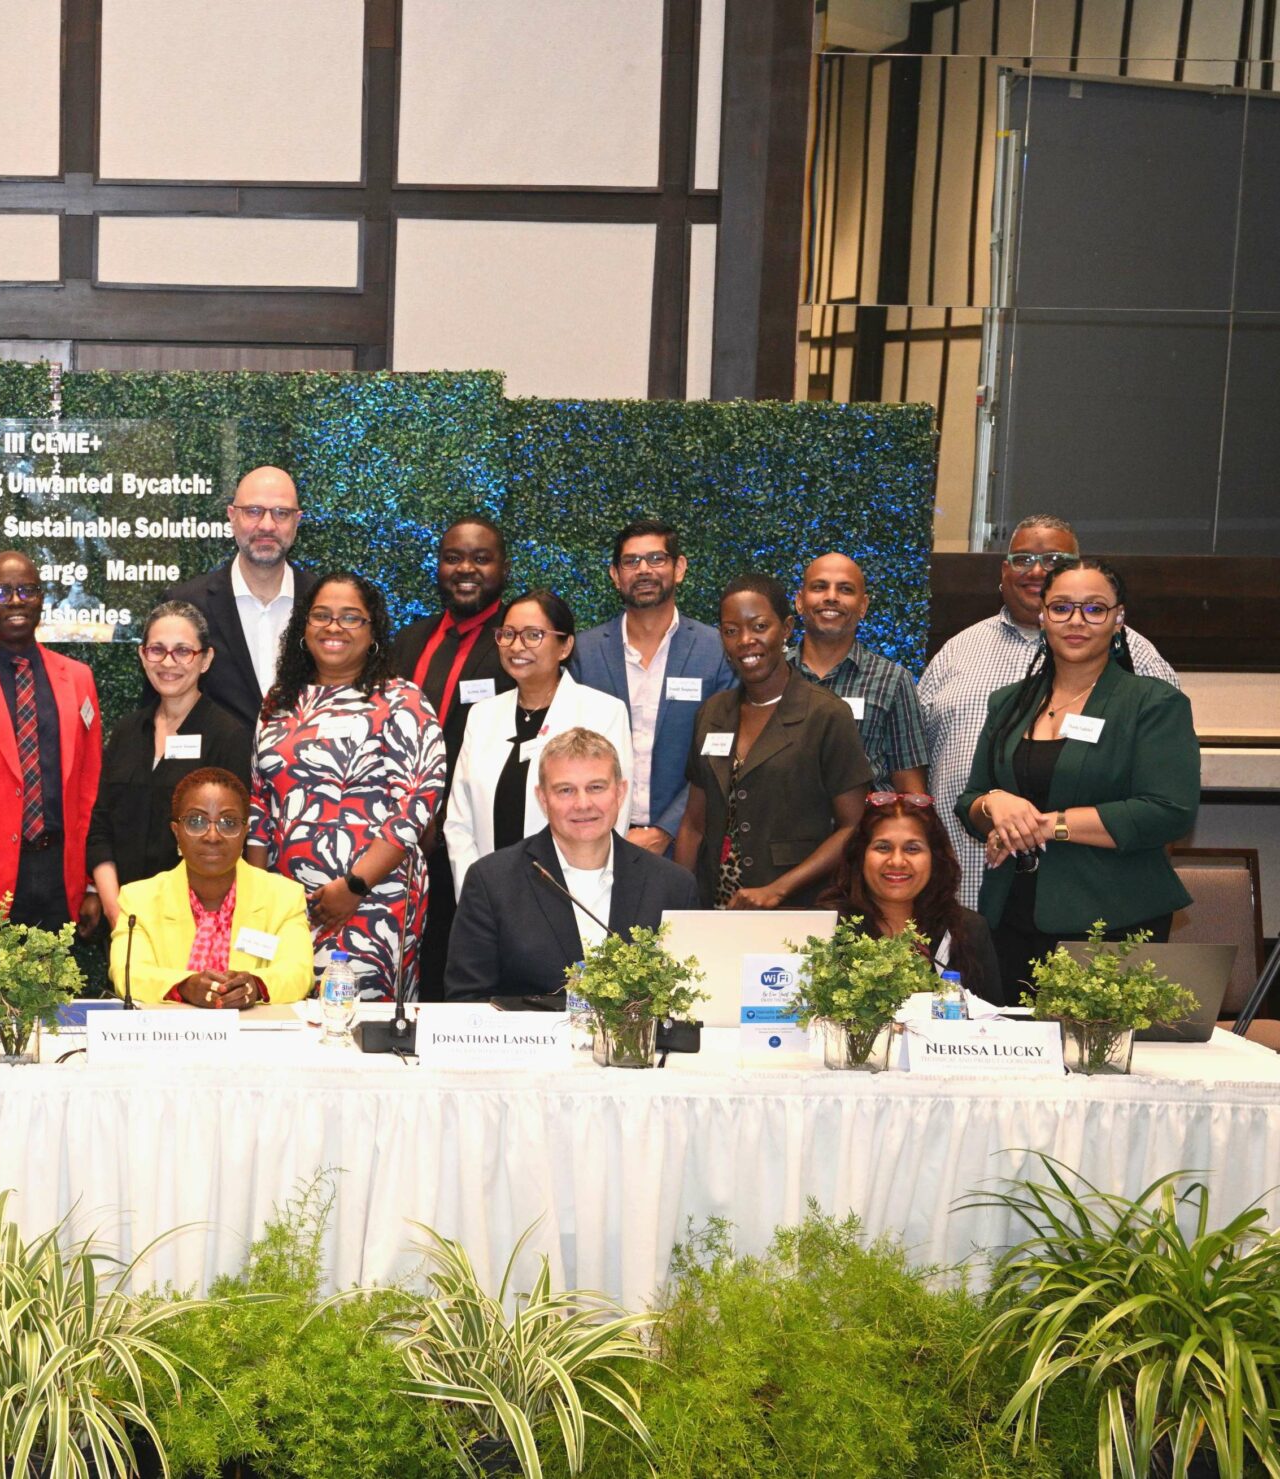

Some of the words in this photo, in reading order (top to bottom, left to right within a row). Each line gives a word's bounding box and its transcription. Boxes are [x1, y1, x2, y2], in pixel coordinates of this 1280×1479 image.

[4, 432, 25, 454] III
[7, 472, 114, 494] Unwanted
[122, 473, 212, 499] Bycatch:
[4, 516, 131, 538] Sustainable
[134, 517, 234, 538] Solutions
[38, 561, 89, 586] arge
[106, 560, 181, 582] Marine
[41, 603, 132, 626] isheries
[101, 1030, 149, 1042] YVETTE
[432, 1032, 500, 1045] JONATHAN
[503, 1033, 558, 1046] LANSLEY
[926, 1042, 989, 1056] NERISSA
[993, 1043, 1045, 1058] LUCKY
